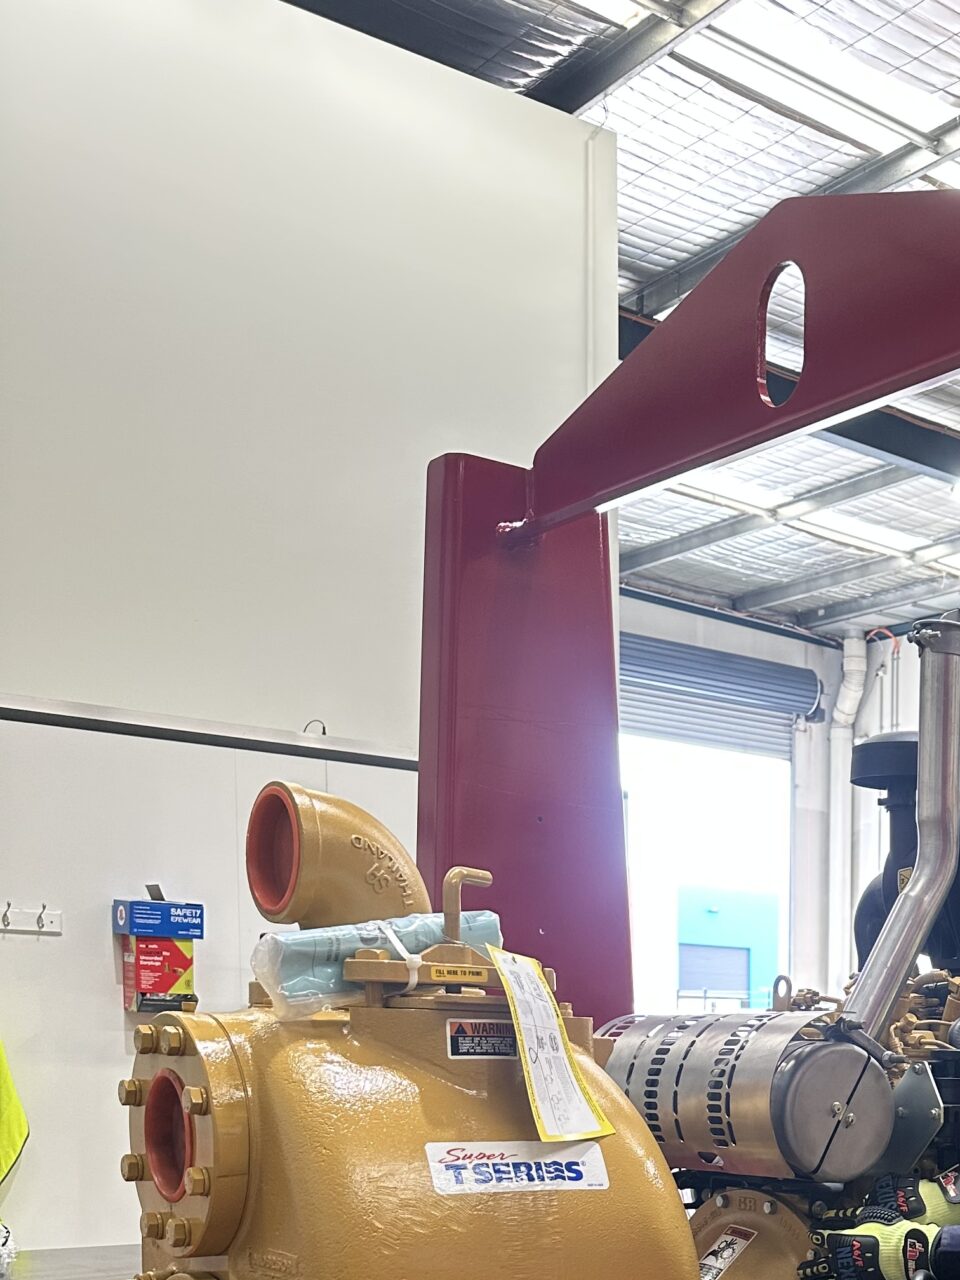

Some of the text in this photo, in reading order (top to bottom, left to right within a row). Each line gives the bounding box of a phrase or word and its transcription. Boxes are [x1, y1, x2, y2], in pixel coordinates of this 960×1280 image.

[170, 908, 201, 916] SAFETY
[471, 1022, 514, 1035] WARNIN
[438, 1147, 518, 1165] Super
